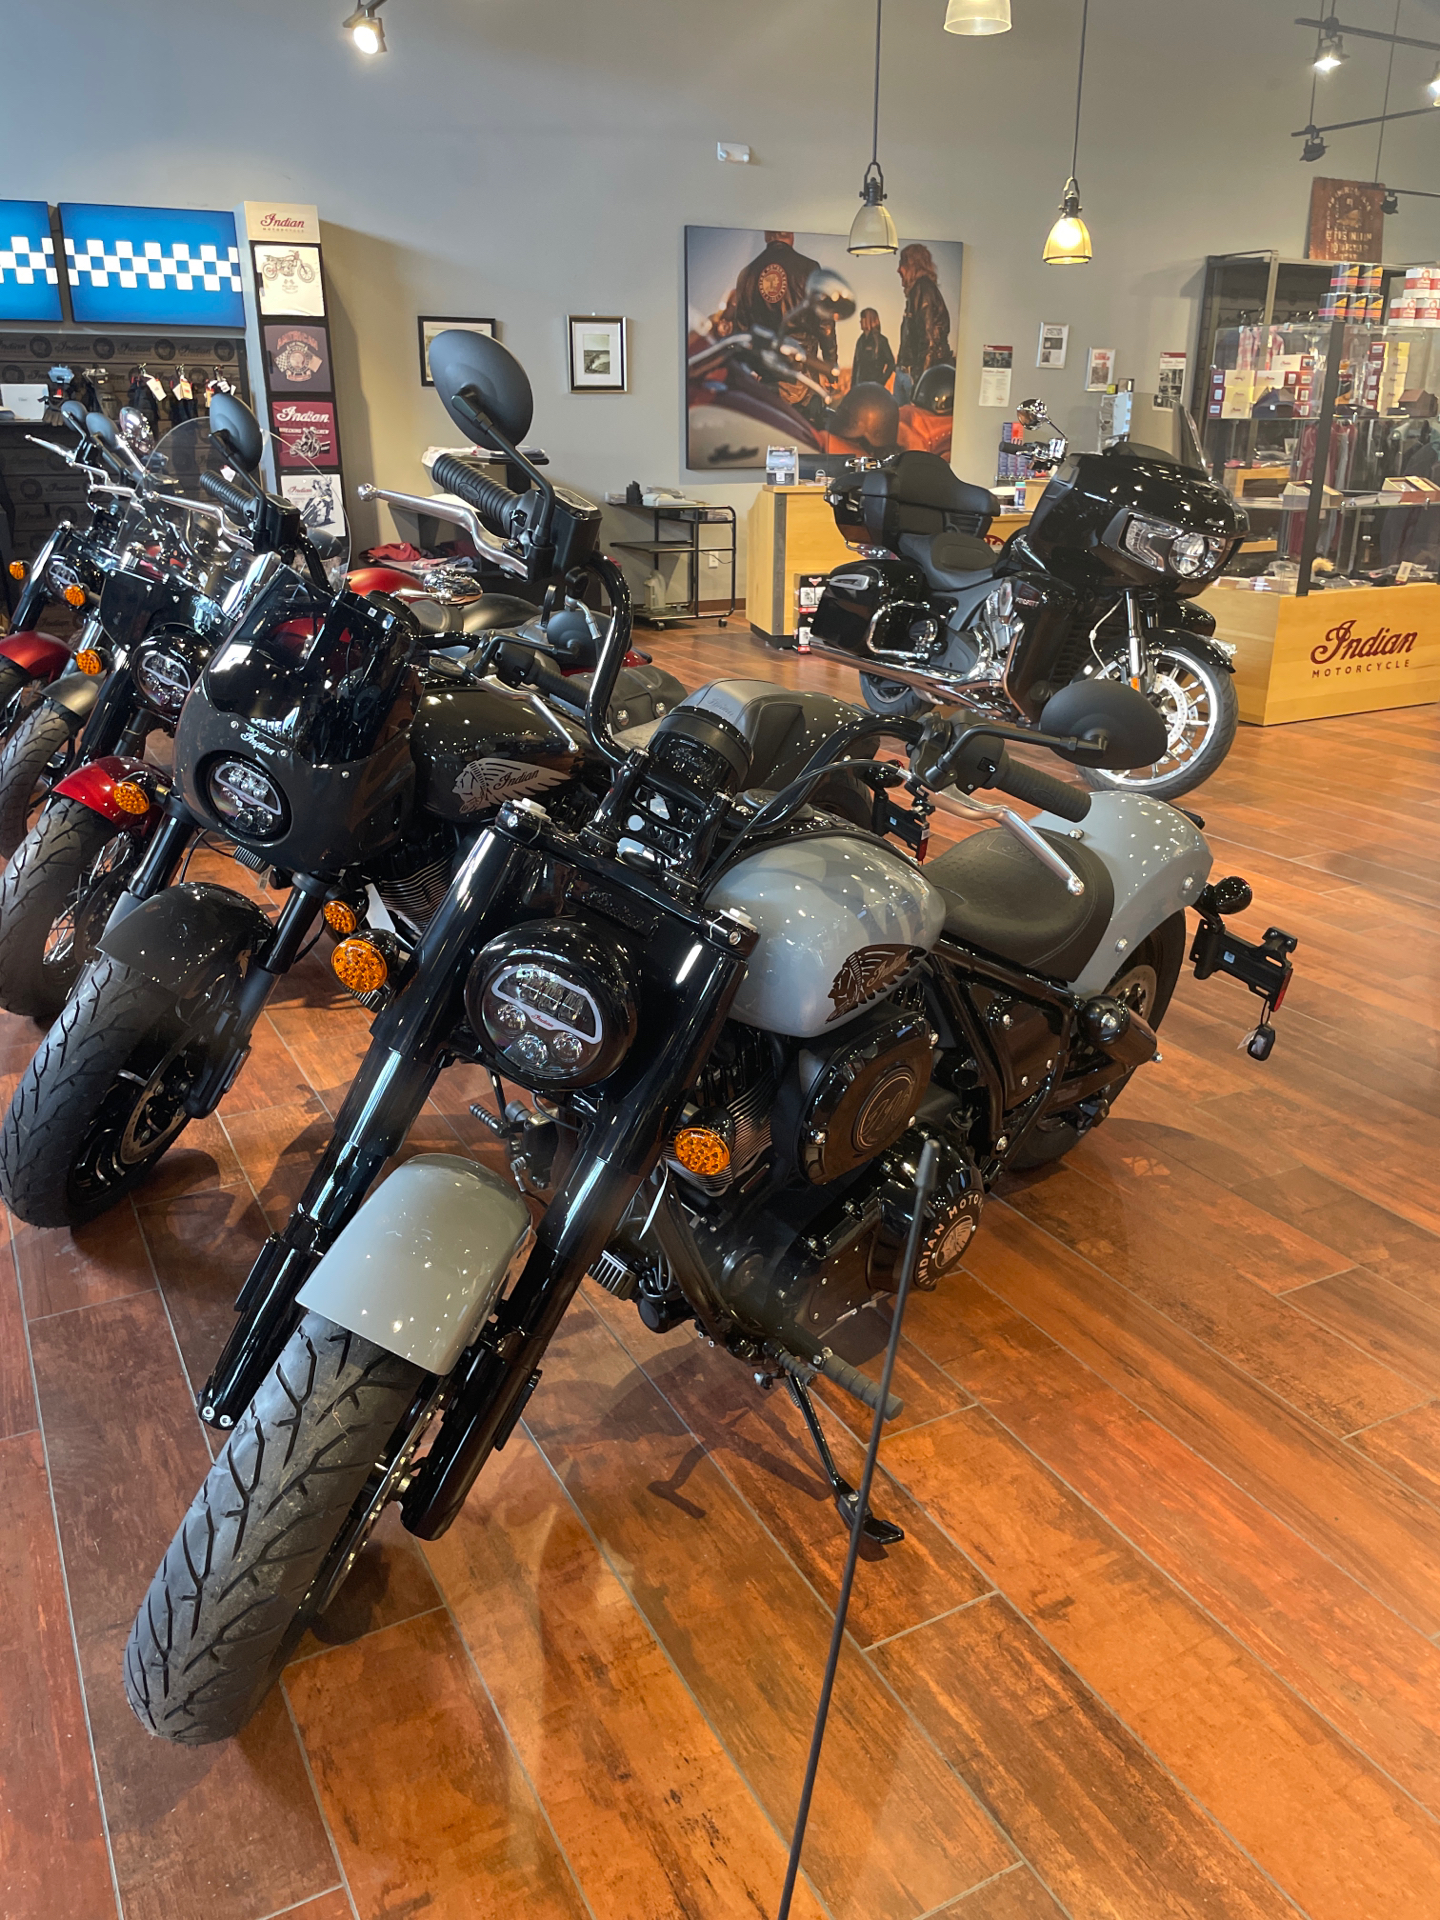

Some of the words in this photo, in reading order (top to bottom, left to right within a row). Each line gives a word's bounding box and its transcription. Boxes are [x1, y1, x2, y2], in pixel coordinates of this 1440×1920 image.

[260, 213, 305, 228] Indian
[276, 406, 330, 423] Indian
[1310, 620, 1418, 665] Indian
[1312, 659, 1411, 679] MOTORCYCLE
[240, 731, 275, 756] Indian
[493, 769, 540, 790] Indian
[531, 1014, 554, 1028] Indian
[918, 1223, 945, 1283] INDIAN
